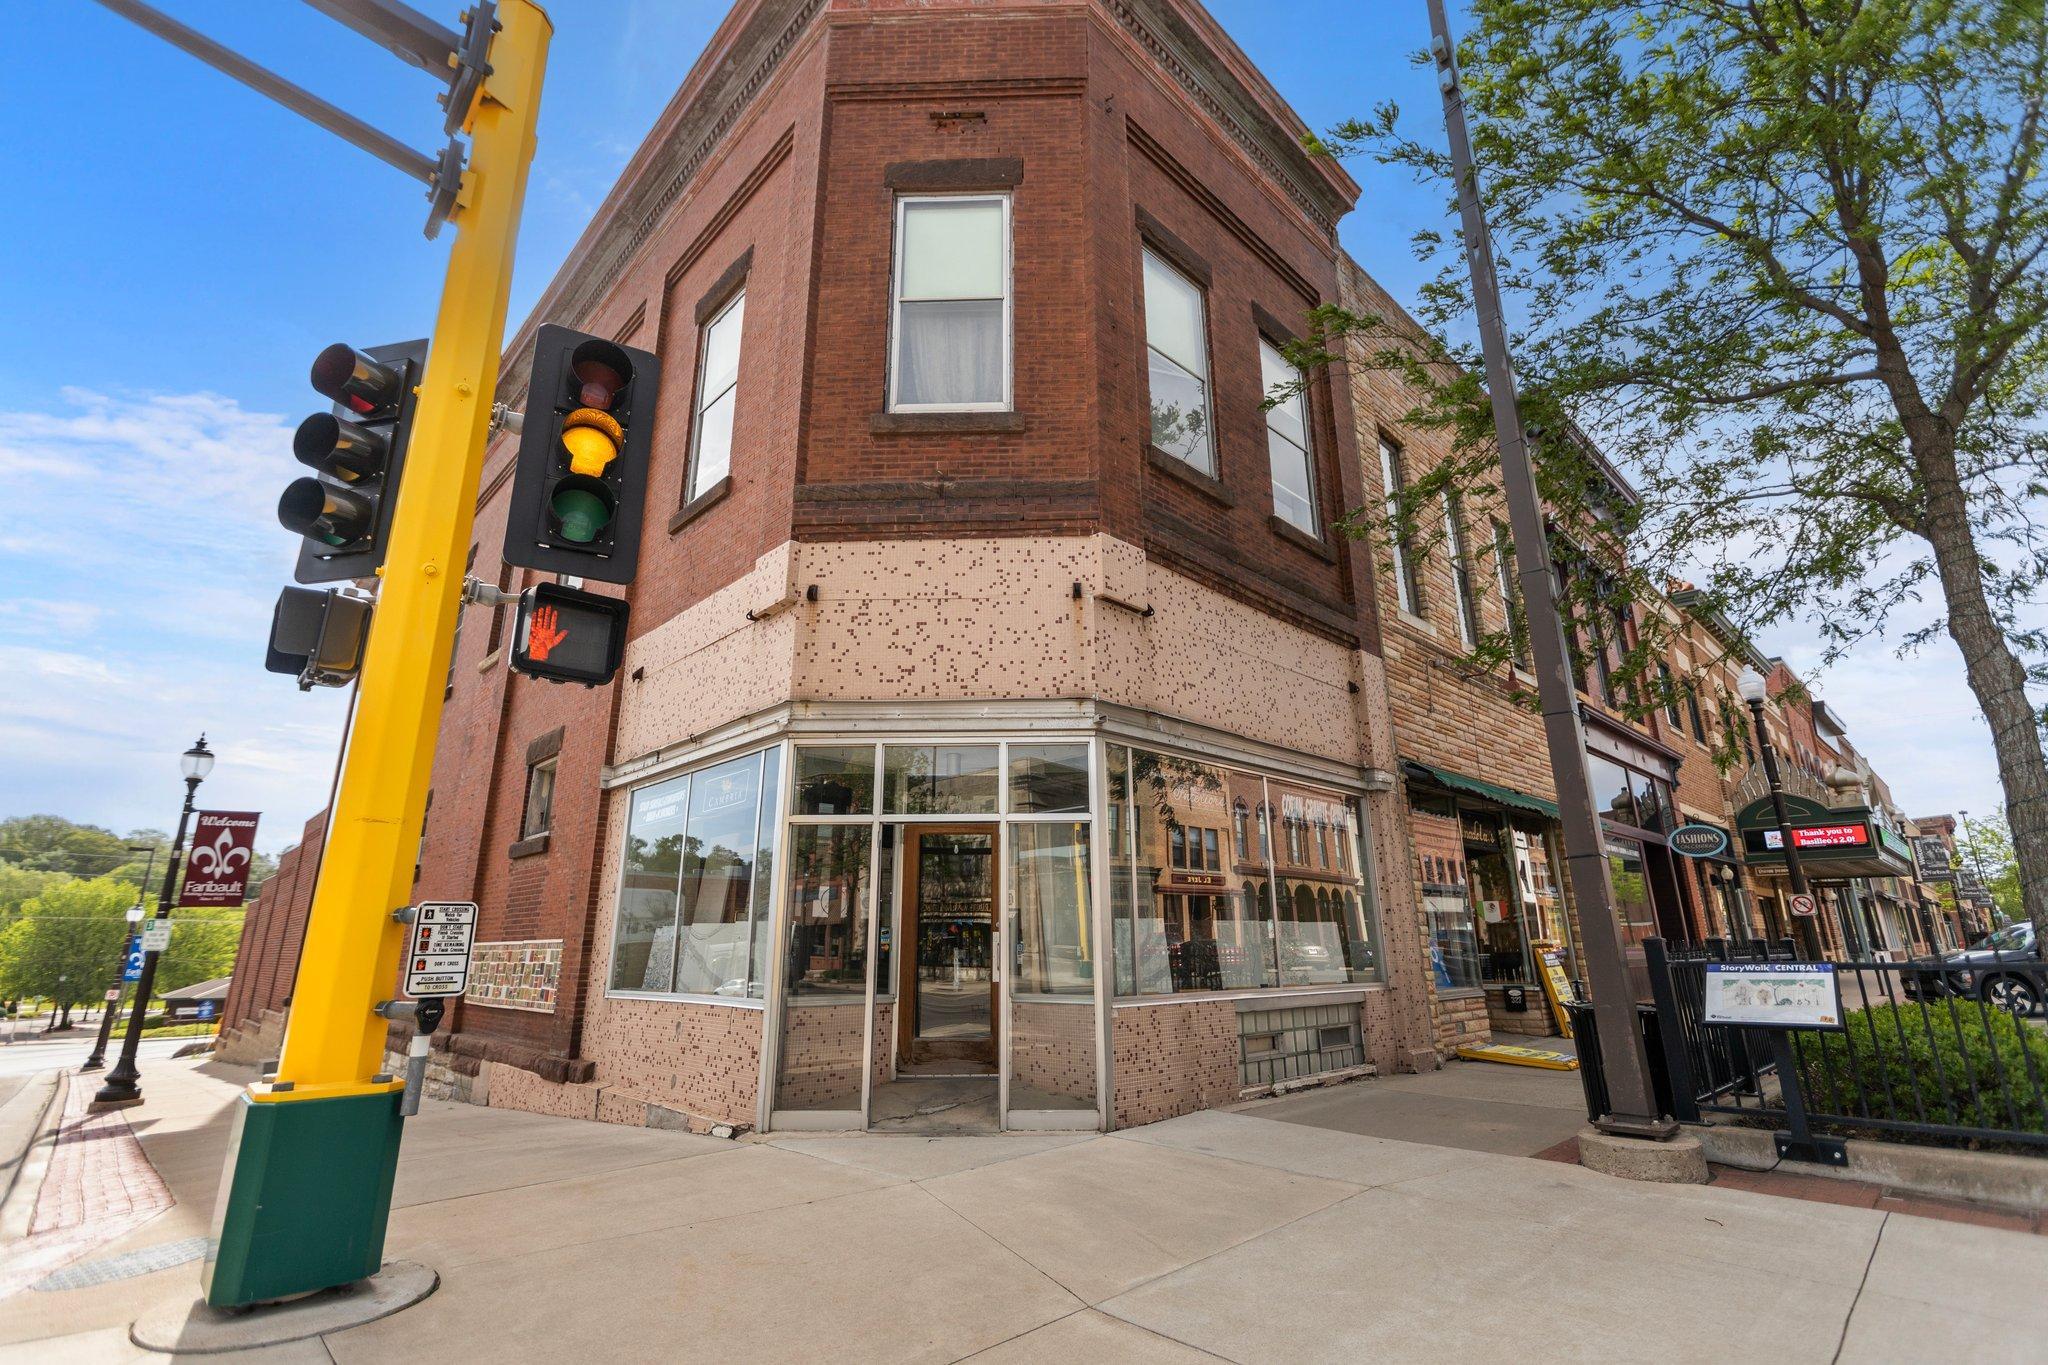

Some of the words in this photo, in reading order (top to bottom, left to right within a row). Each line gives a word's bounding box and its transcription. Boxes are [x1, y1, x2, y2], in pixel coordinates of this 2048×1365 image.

[201, 816, 256, 827] Welcome
[1798, 827, 1826, 837] Thank
[1827, 829, 1843, 837] you
[1675, 833, 1720, 844] FASHIONS
[185, 881, 243, 892] Faribault
[1774, 964, 1819, 972] CENTRAL
